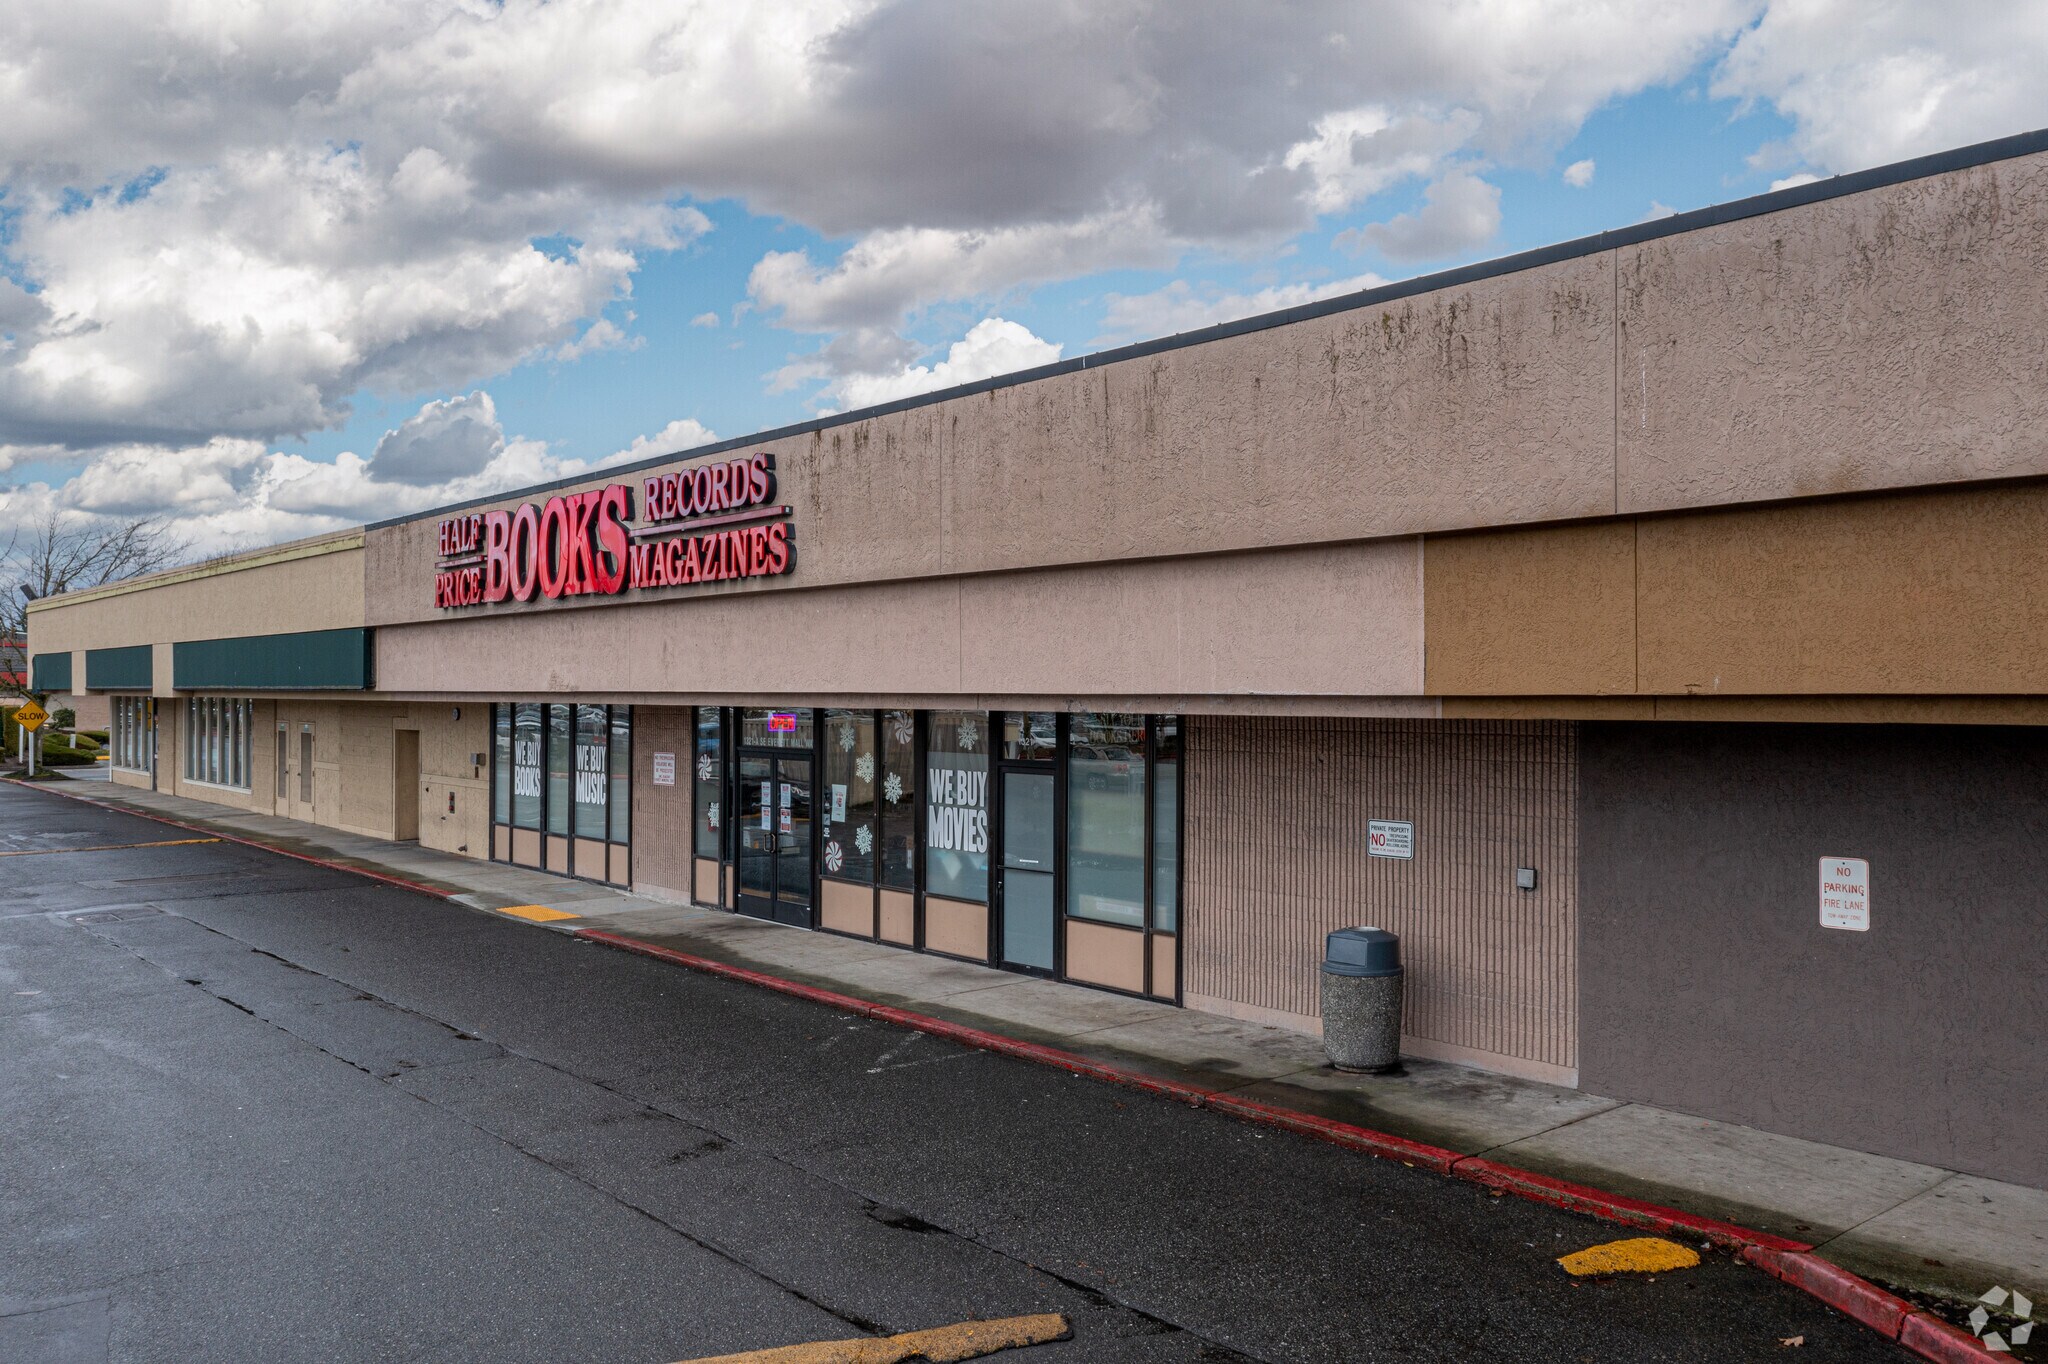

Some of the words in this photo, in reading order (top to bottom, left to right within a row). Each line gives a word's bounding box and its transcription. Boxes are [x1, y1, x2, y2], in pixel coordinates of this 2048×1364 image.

[643, 453, 775, 521] RECORDS
[438, 513, 484, 556] HALF
[481, 484, 634, 602] BOOKS
[629, 522, 795, 589] MAGAZINES
[434, 567, 484, 608] PRICE
[18, 712, 45, 720] SLOW
[770, 716, 795, 730] OPEN
[515, 741, 526, 765] WE
[527, 742, 541, 766] BUY
[760, 737, 766, 746] SE
[768, 738, 789, 747] EVETT
[577, 745, 589, 771] WE
[590, 746, 606, 772] BUY
[515, 766, 541, 797] BOOKS
[576, 772, 606, 805] MUSIC
[930, 768, 953, 804] WE
[957, 770, 987, 807] BUY
[929, 806, 987, 853] MOVIES
[1371, 833, 1386, 846] NO
[1837, 867, 1851, 876] NO
[1824, 883, 1864, 894] PARKING
[1824, 899, 1840, 908] FIRE
[1845, 900, 1864, 910] LANE
